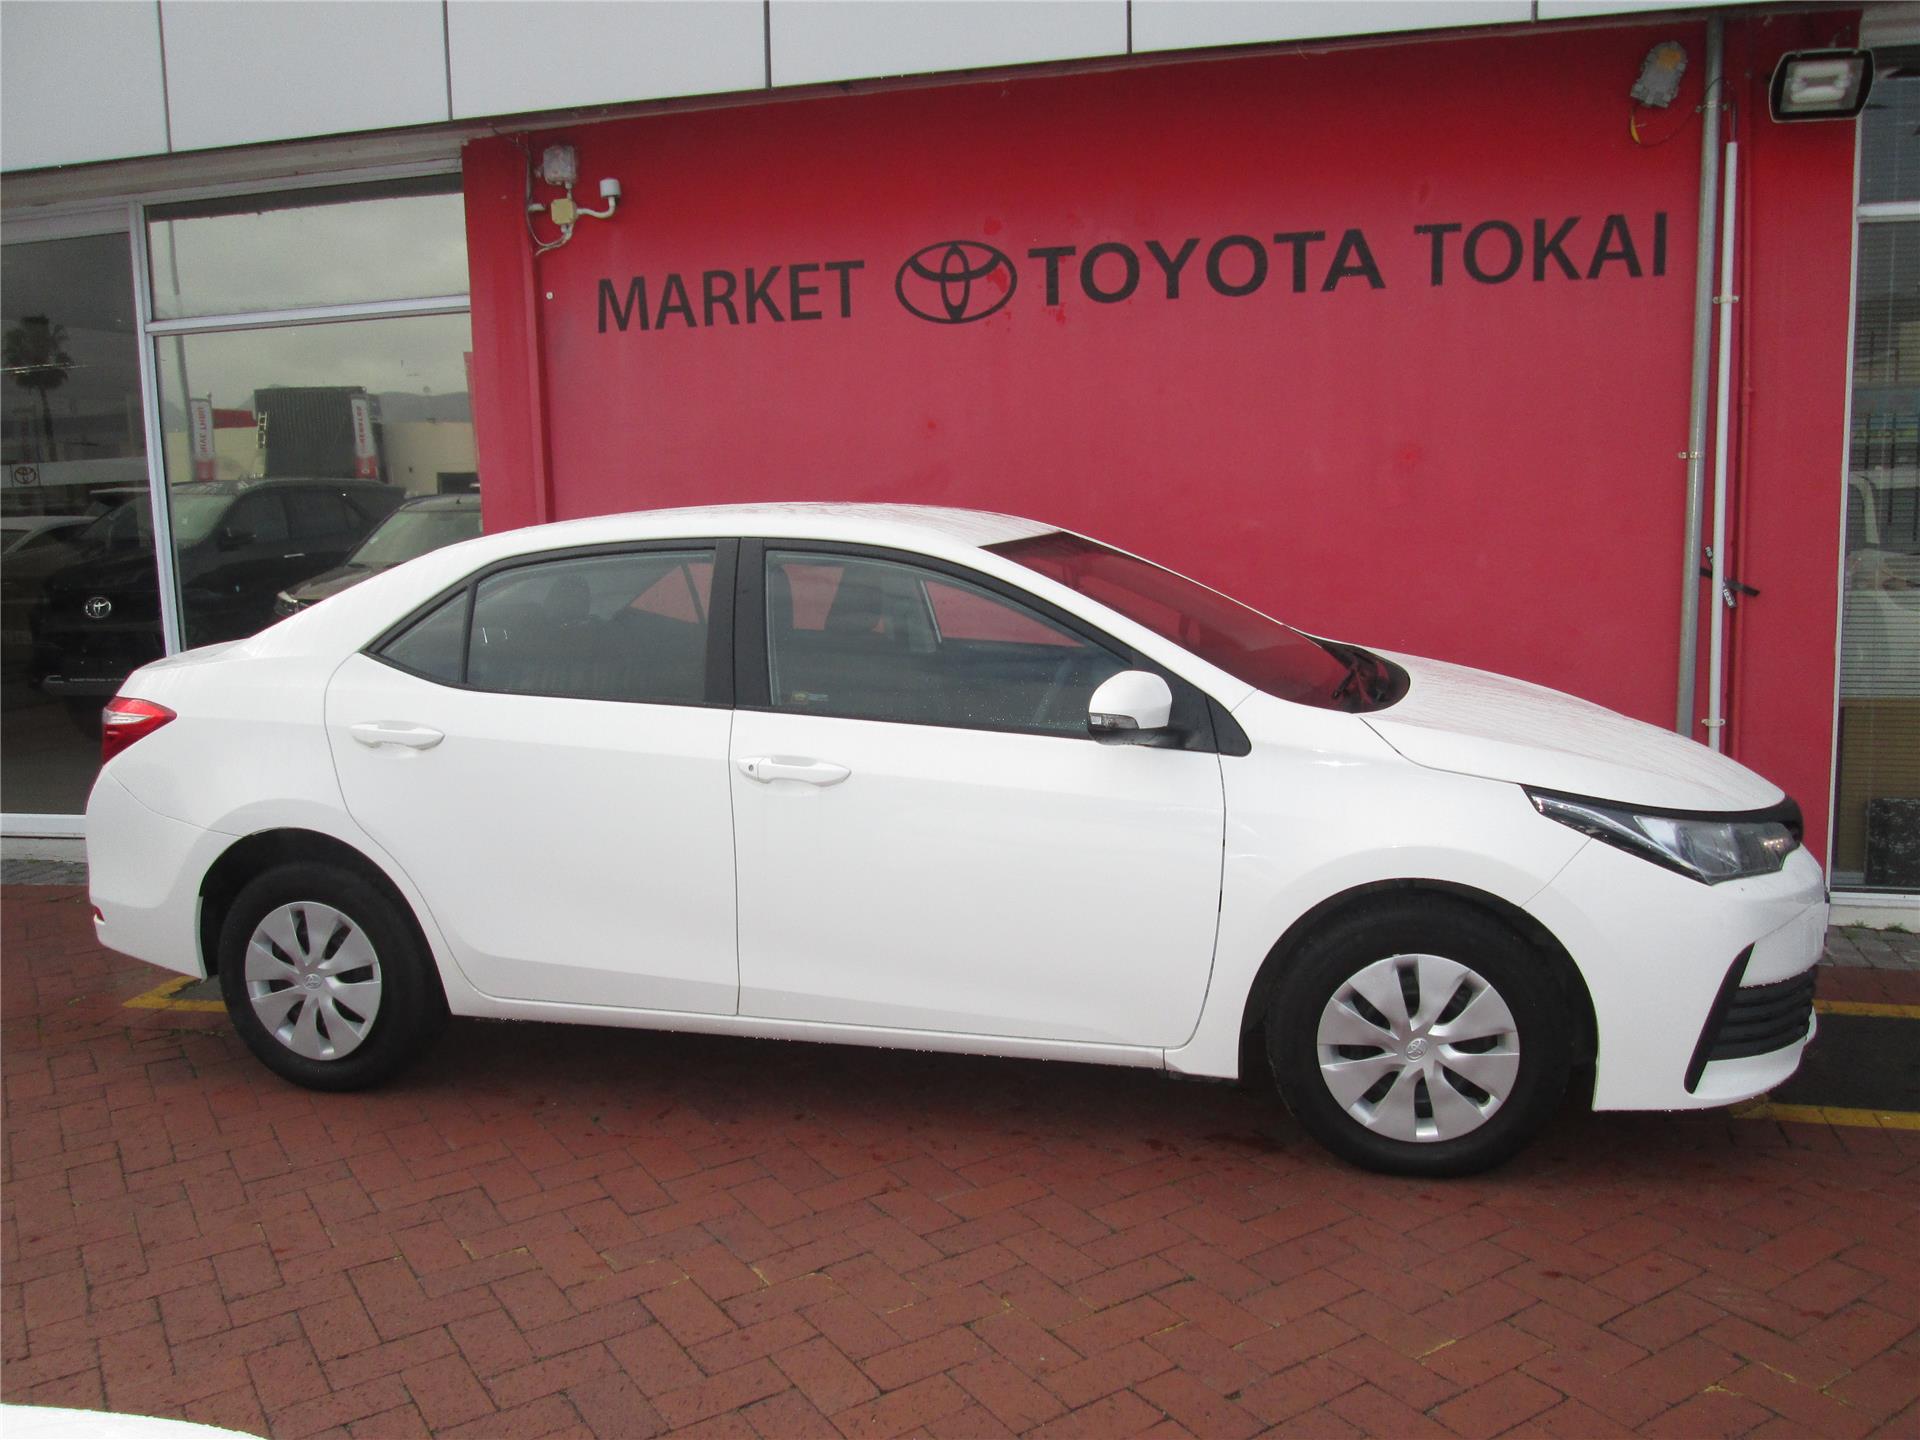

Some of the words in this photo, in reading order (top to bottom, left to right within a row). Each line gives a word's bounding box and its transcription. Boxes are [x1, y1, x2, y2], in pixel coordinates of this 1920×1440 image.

[598, 261, 865, 333] MARKET
[1028, 228, 1386, 306] TOYOTA
[1415, 212, 1668, 287] TOKAI
